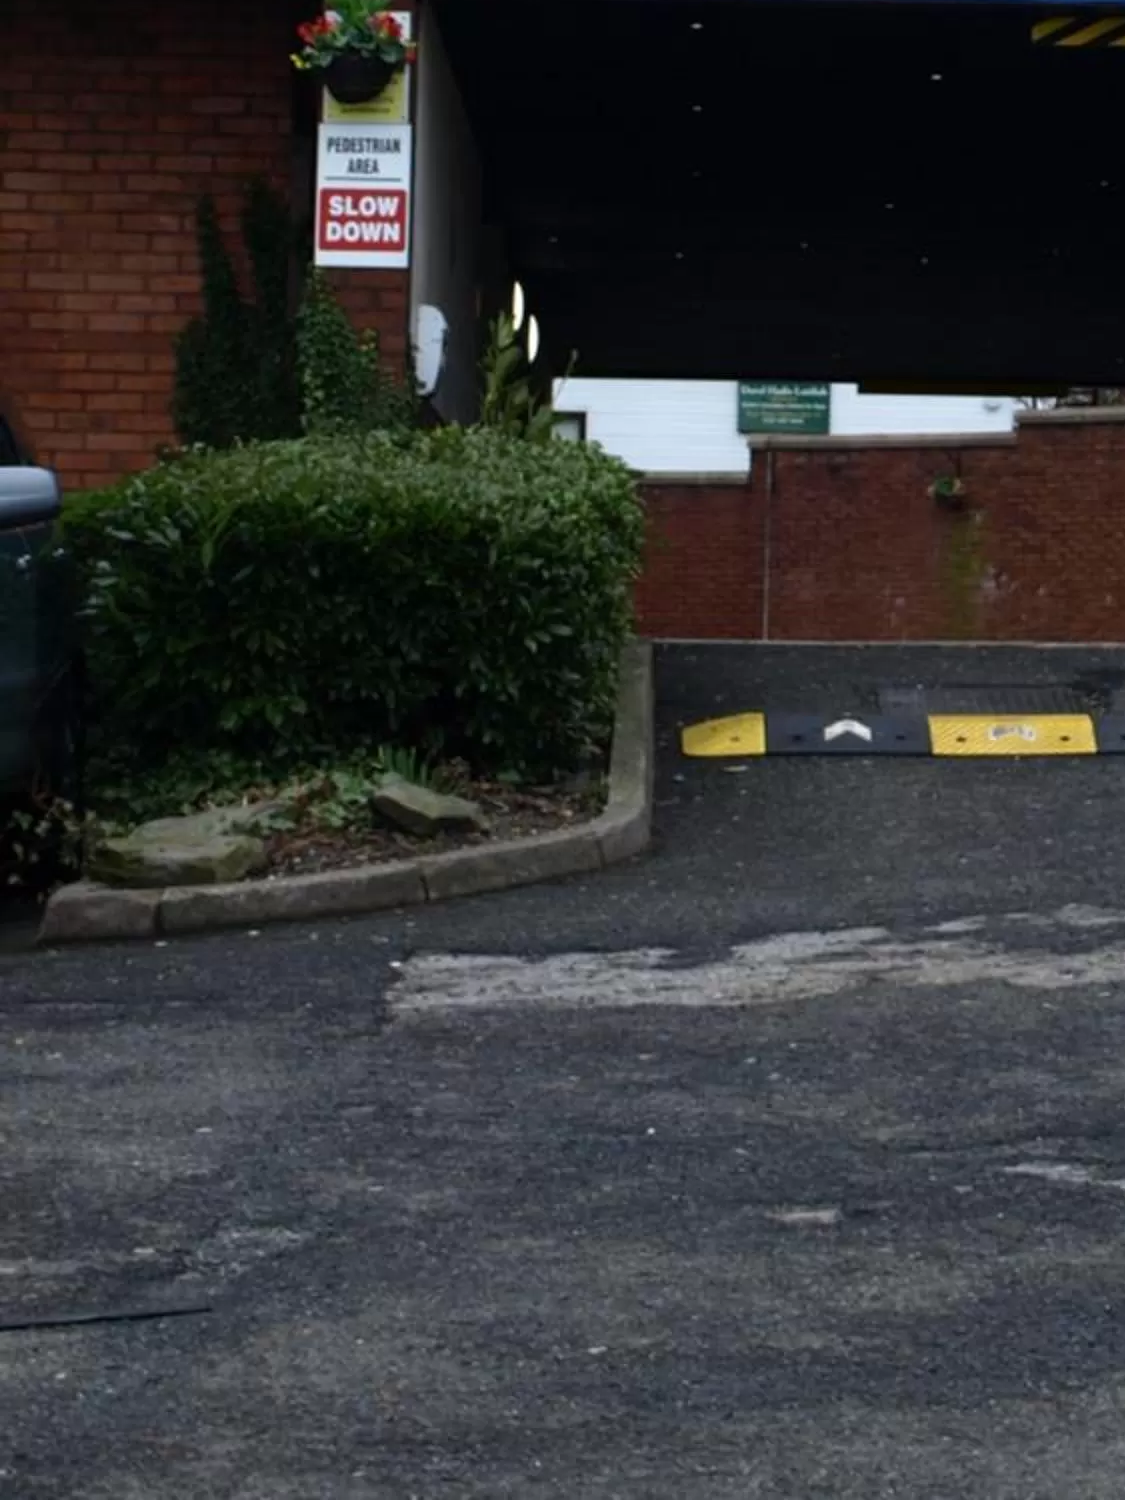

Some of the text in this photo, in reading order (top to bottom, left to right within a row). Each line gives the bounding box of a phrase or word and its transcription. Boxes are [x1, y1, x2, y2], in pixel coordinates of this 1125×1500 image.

[327, 137, 401, 153] PEDESTRIAN
[348, 159, 380, 174] AREA
[329, 196, 400, 217] SLOW
[326, 221, 400, 242] DOWN
